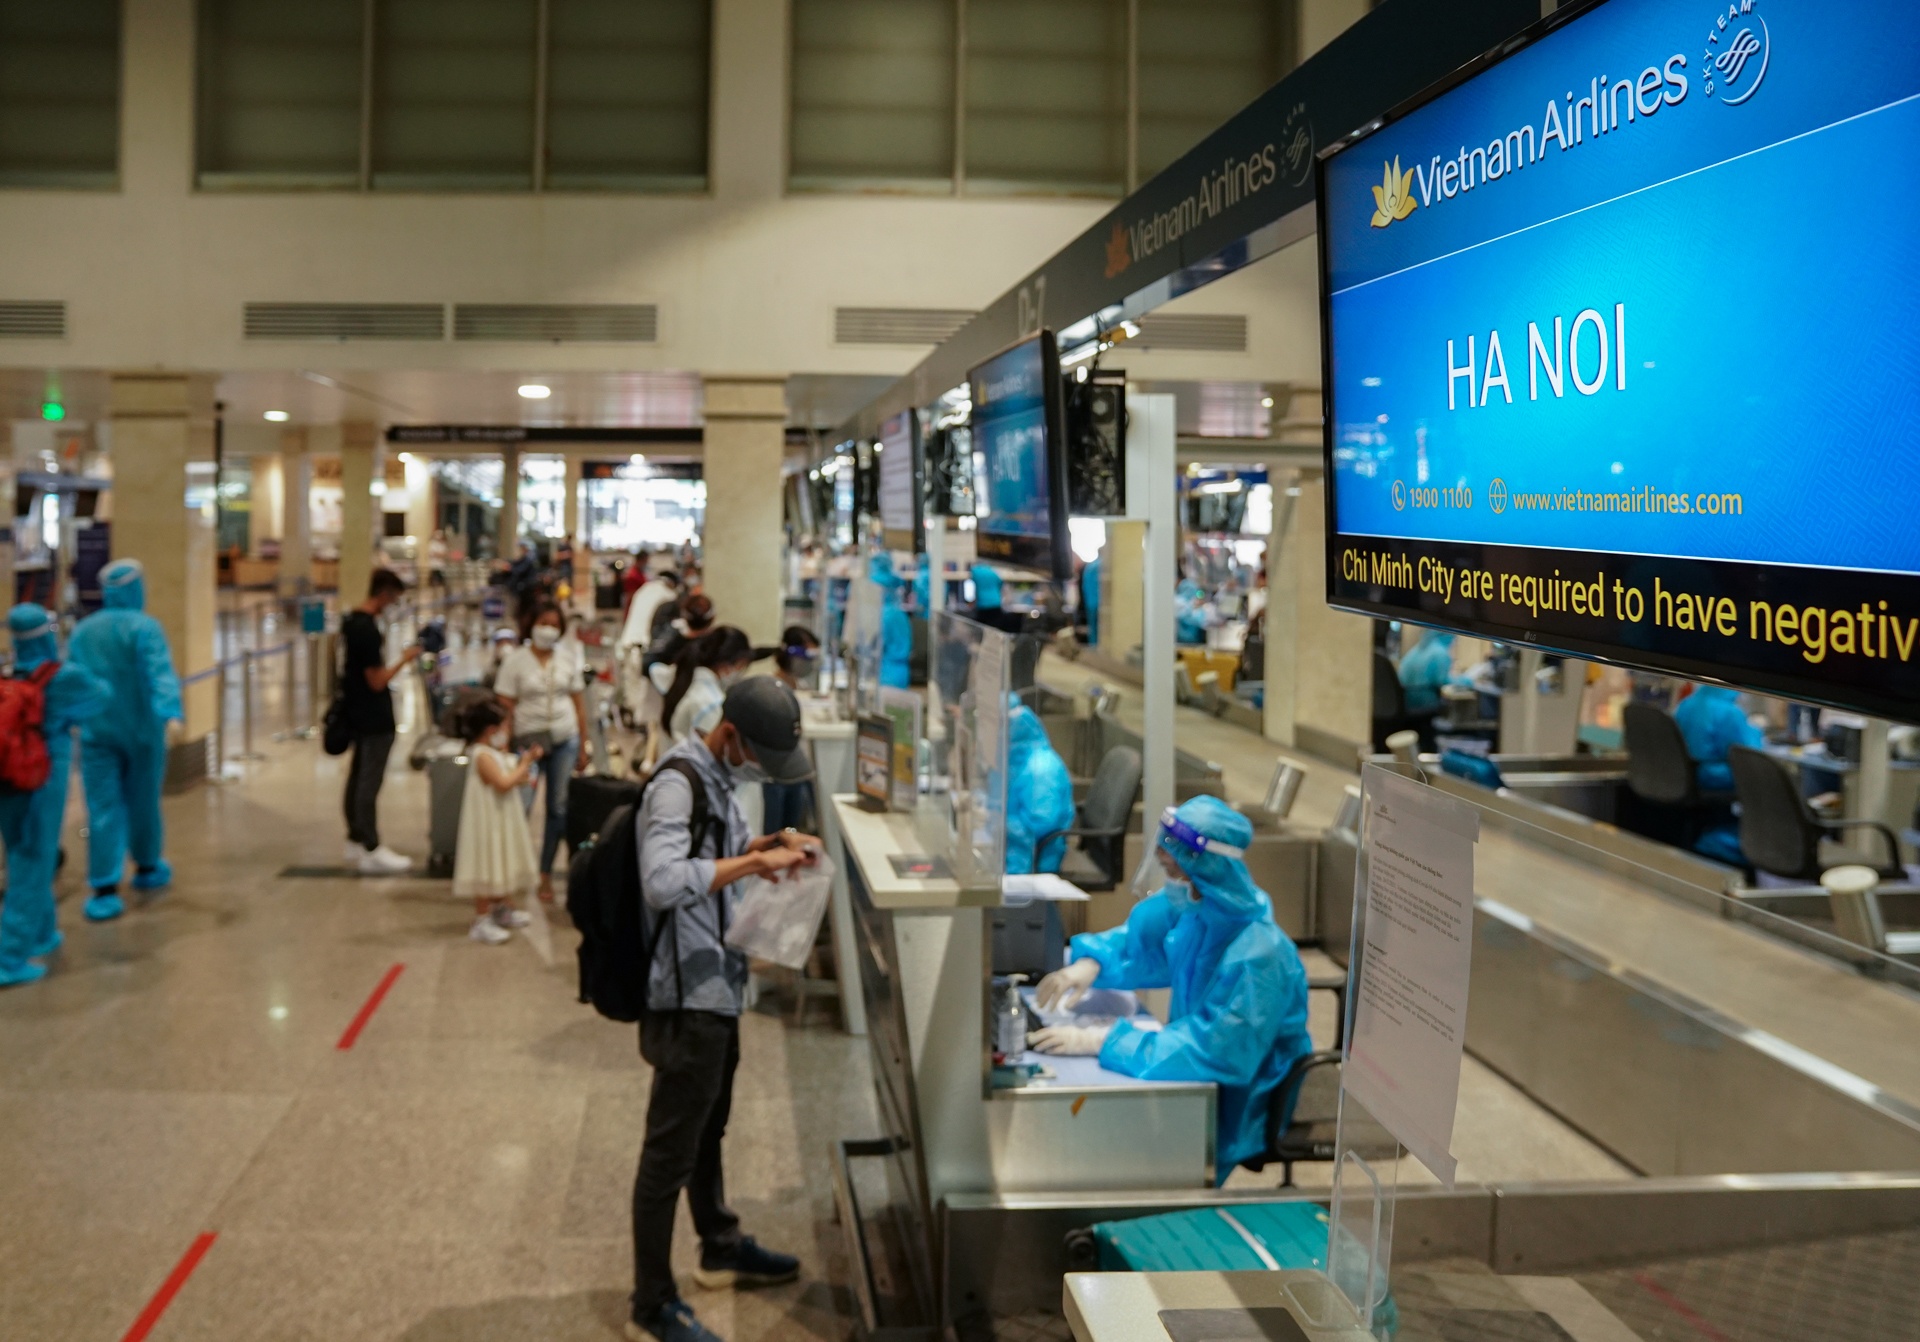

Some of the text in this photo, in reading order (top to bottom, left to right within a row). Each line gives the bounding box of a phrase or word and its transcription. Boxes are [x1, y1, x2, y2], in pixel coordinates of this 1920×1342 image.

[1702, 0, 1752, 95] SKYTEAM
[1416, 53, 1689, 208] Vietnam Airlines
[1130, 143, 1276, 263] Vietnam Airlines
[1447, 303, 1626, 411] HA NOI
[1410, 487, 1473, 509] 1900 1100
[1512, 485, 1743, 515] www.vietnamairlines.com
[1343, 548, 1919, 663] Chi Minh City are required to have negativ
